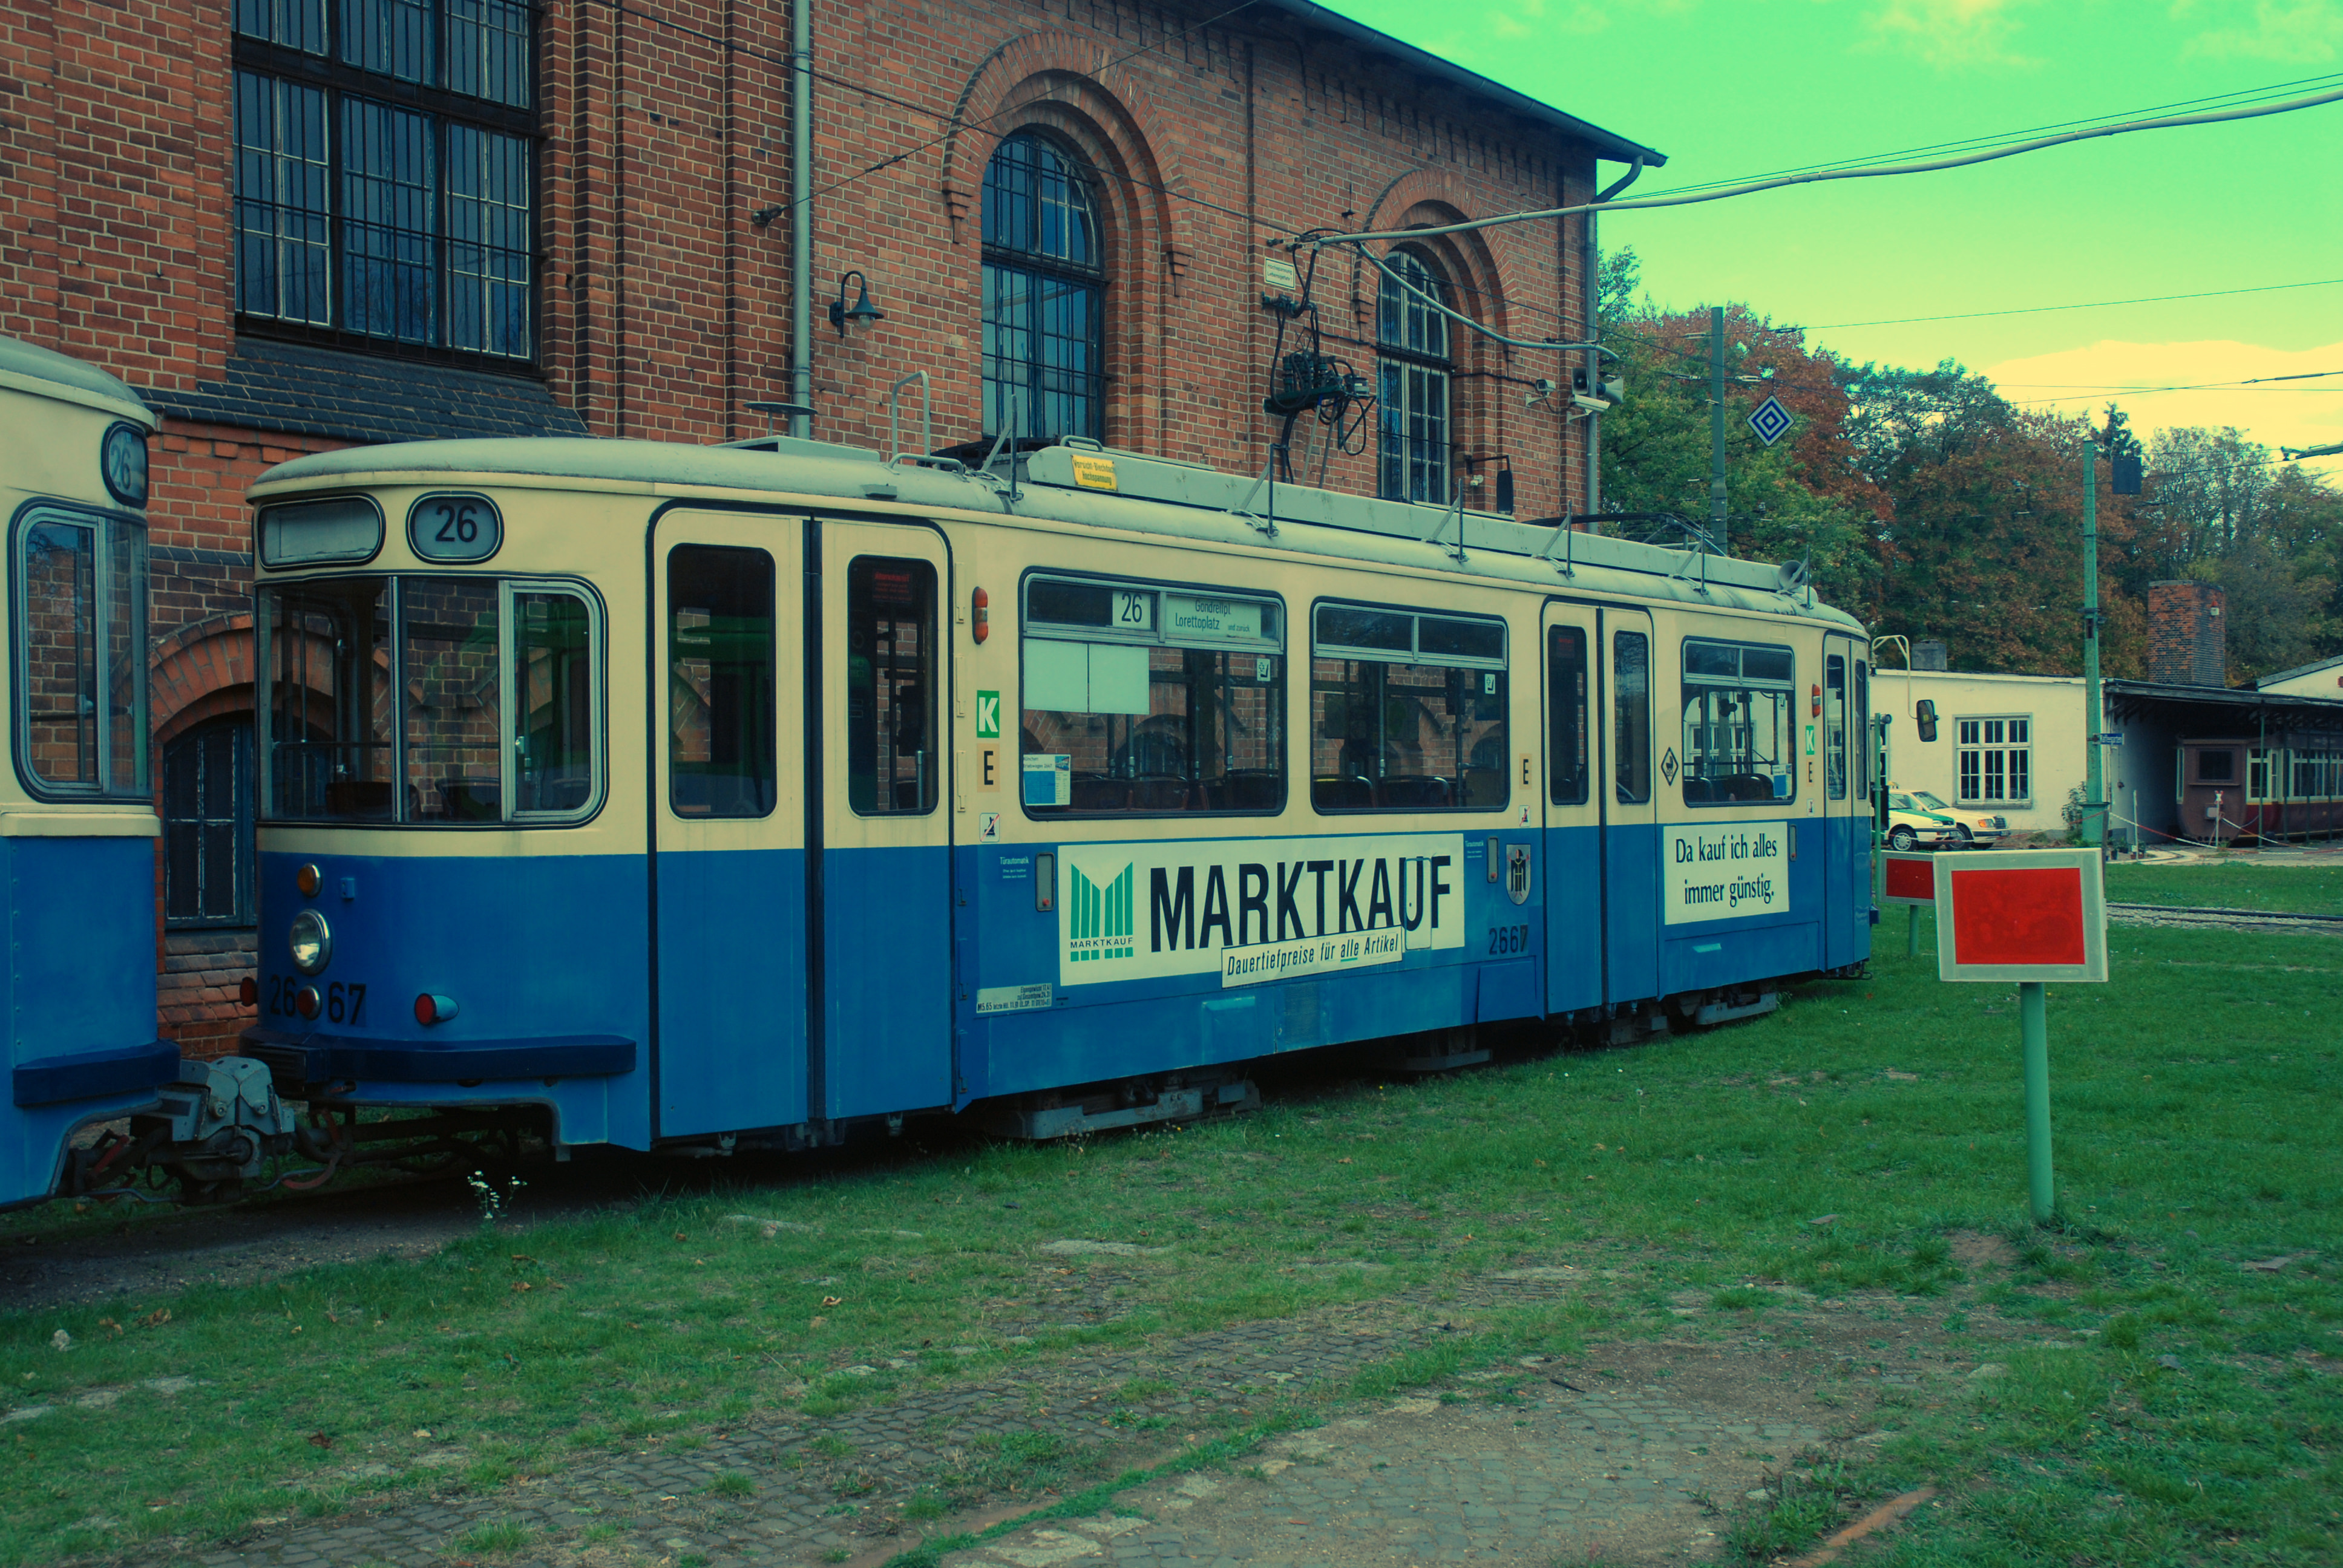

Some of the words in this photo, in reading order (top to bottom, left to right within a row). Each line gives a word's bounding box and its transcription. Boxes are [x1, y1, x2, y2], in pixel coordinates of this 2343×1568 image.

[110, 445, 131, 491] 26
[1082, 471, 1112, 486] Hochspannung
[435, 504, 478, 543] 26
[1121, 592, 1142, 623] 26
[1175, 612, 1220, 632] Lorettoplatz
[1236, 624, 1250, 632] zurück
[979, 697, 998, 732] K
[1806, 730, 1814, 751] K
[984, 751, 994, 785] E
[1523, 759, 1529, 785] E
[1809, 762, 1813, 783] E
[1000, 856, 1029, 865] Türautomatik
[1676, 838, 1693, 863] Da
[1699, 834, 1726, 861] kauf
[1731, 834, 1748, 859] ich
[1753, 833, 1777, 858] alles
[1150, 855, 1451, 953] MARKTKAUF
[1685, 878, 1725, 904] immer
[1729, 872, 1774, 907] günstig.
[1070, 937, 1133, 949] MARKTKAUF
[1227, 945, 1314, 976] Dauertiefpreise
[1320, 941, 1335, 961] für
[1340, 939, 1359, 958] alle
[1364, 933, 1398, 955] Artikel
[1489, 924, 1528, 955] 2667
